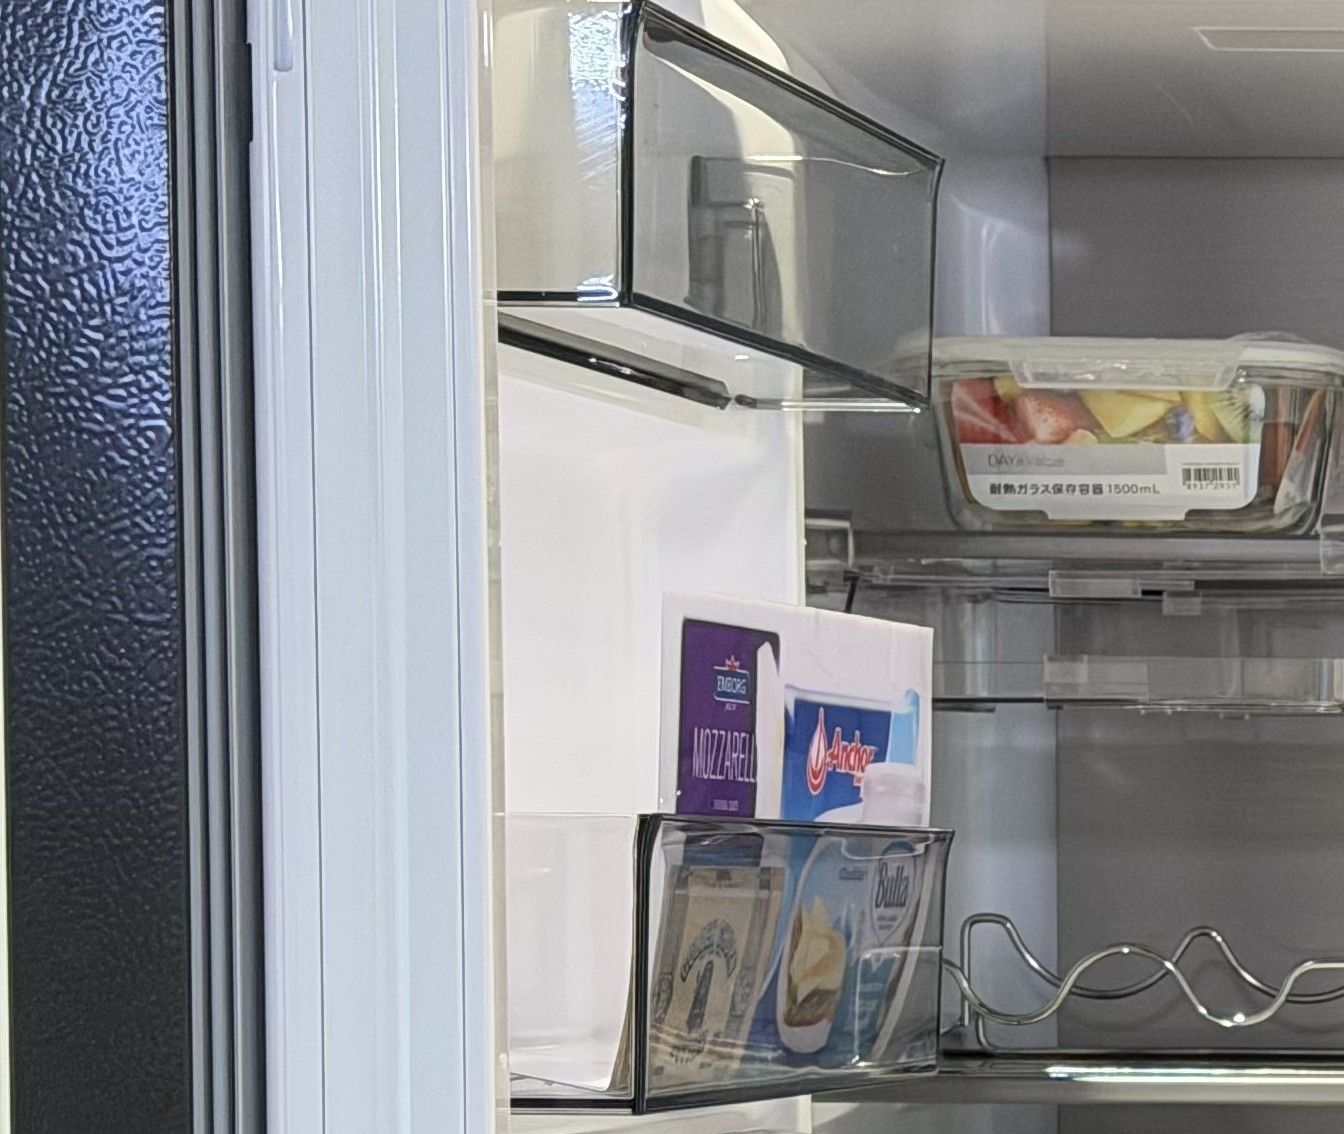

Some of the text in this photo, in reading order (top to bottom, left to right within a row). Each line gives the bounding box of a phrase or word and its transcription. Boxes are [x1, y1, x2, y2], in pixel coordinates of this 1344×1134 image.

[1107, 484, 1160, 495] 1500mL
[692, 727, 758, 783] MOZZARELL
[875, 862, 909, 908] Bulla
